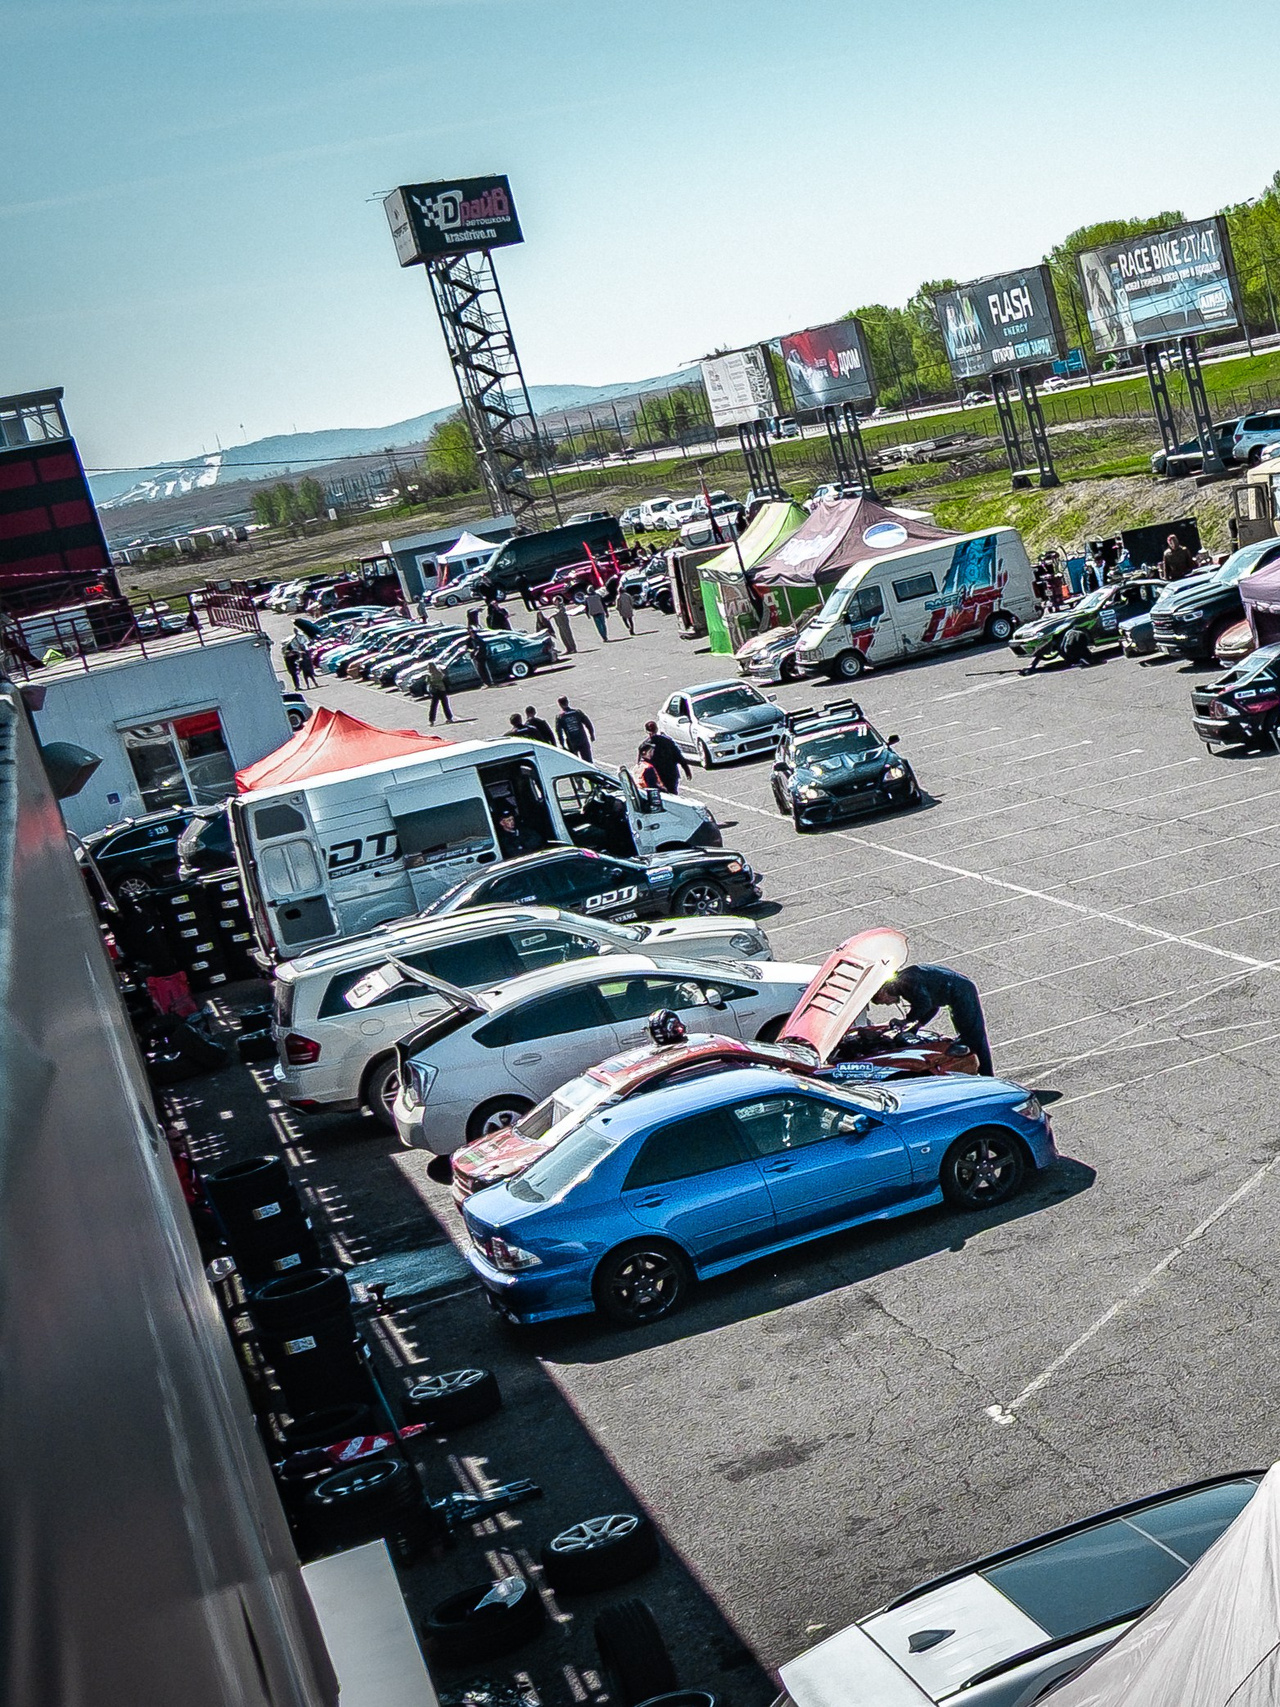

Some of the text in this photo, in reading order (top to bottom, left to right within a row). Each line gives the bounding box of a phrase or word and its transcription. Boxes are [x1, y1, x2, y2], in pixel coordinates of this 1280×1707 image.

[444, 228, 497, 243] krasdrive.ru
[1117, 229, 1217, 278] RACE BIKE 2T/4T
[987, 285, 1034, 325] FLASH
[1003, 323, 1028, 337] ENERGY
[586, 885, 638, 909] ODT
